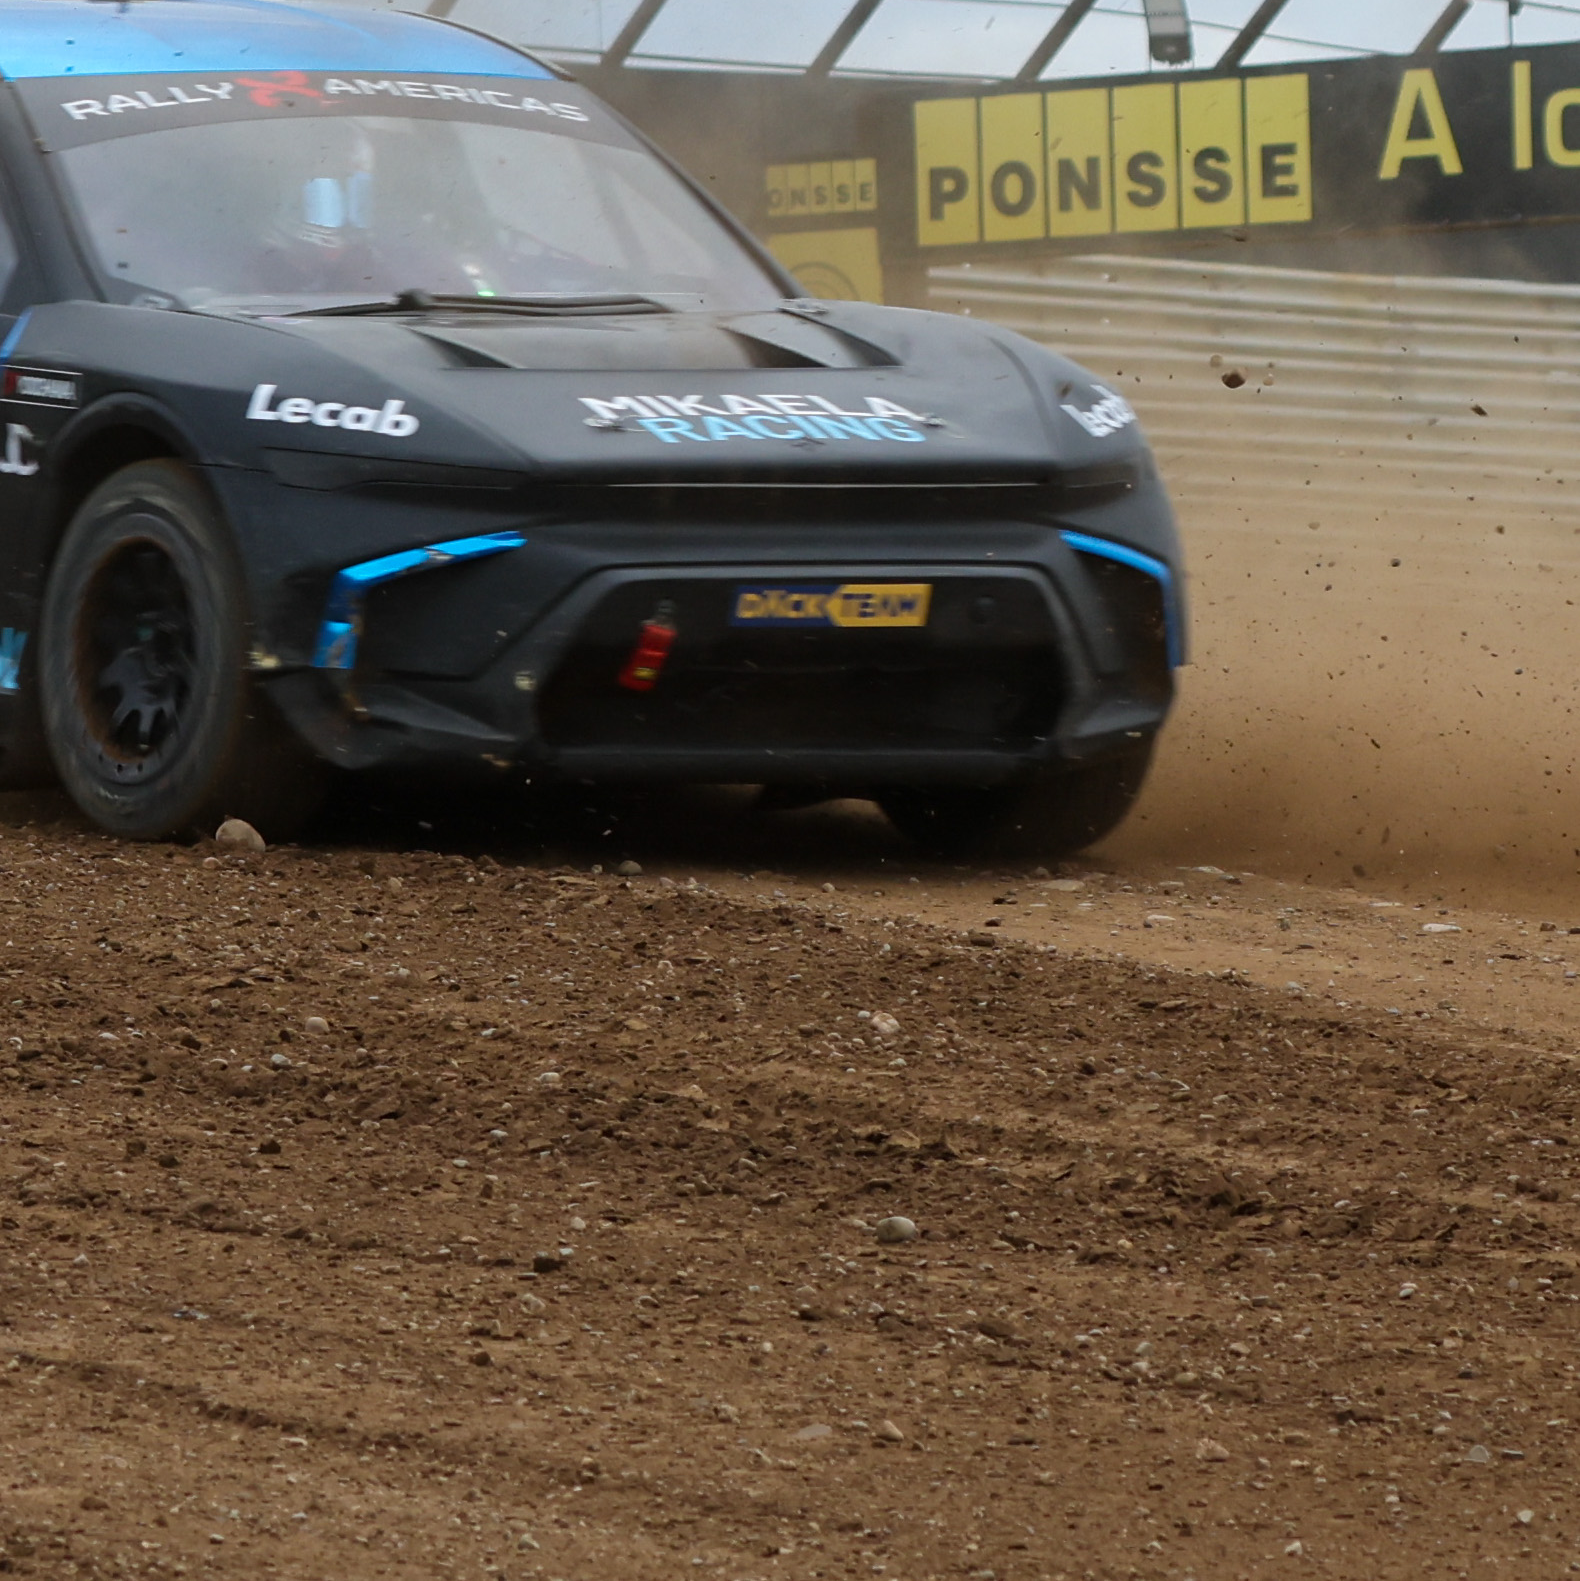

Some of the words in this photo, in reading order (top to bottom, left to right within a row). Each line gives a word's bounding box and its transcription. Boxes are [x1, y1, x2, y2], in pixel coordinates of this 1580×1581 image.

[60, 82, 235, 122] RALLY
[323, 79, 591, 122] AMERICAS
[1379, 67, 1464, 181] A
[768, 183, 873, 209] ONSSE
[929, 142, 1300, 221] PONSSE
[245, 383, 421, 439] Lecab
[578, 393, 931, 422] MIKAELA
[638, 415, 927, 444] RACING
